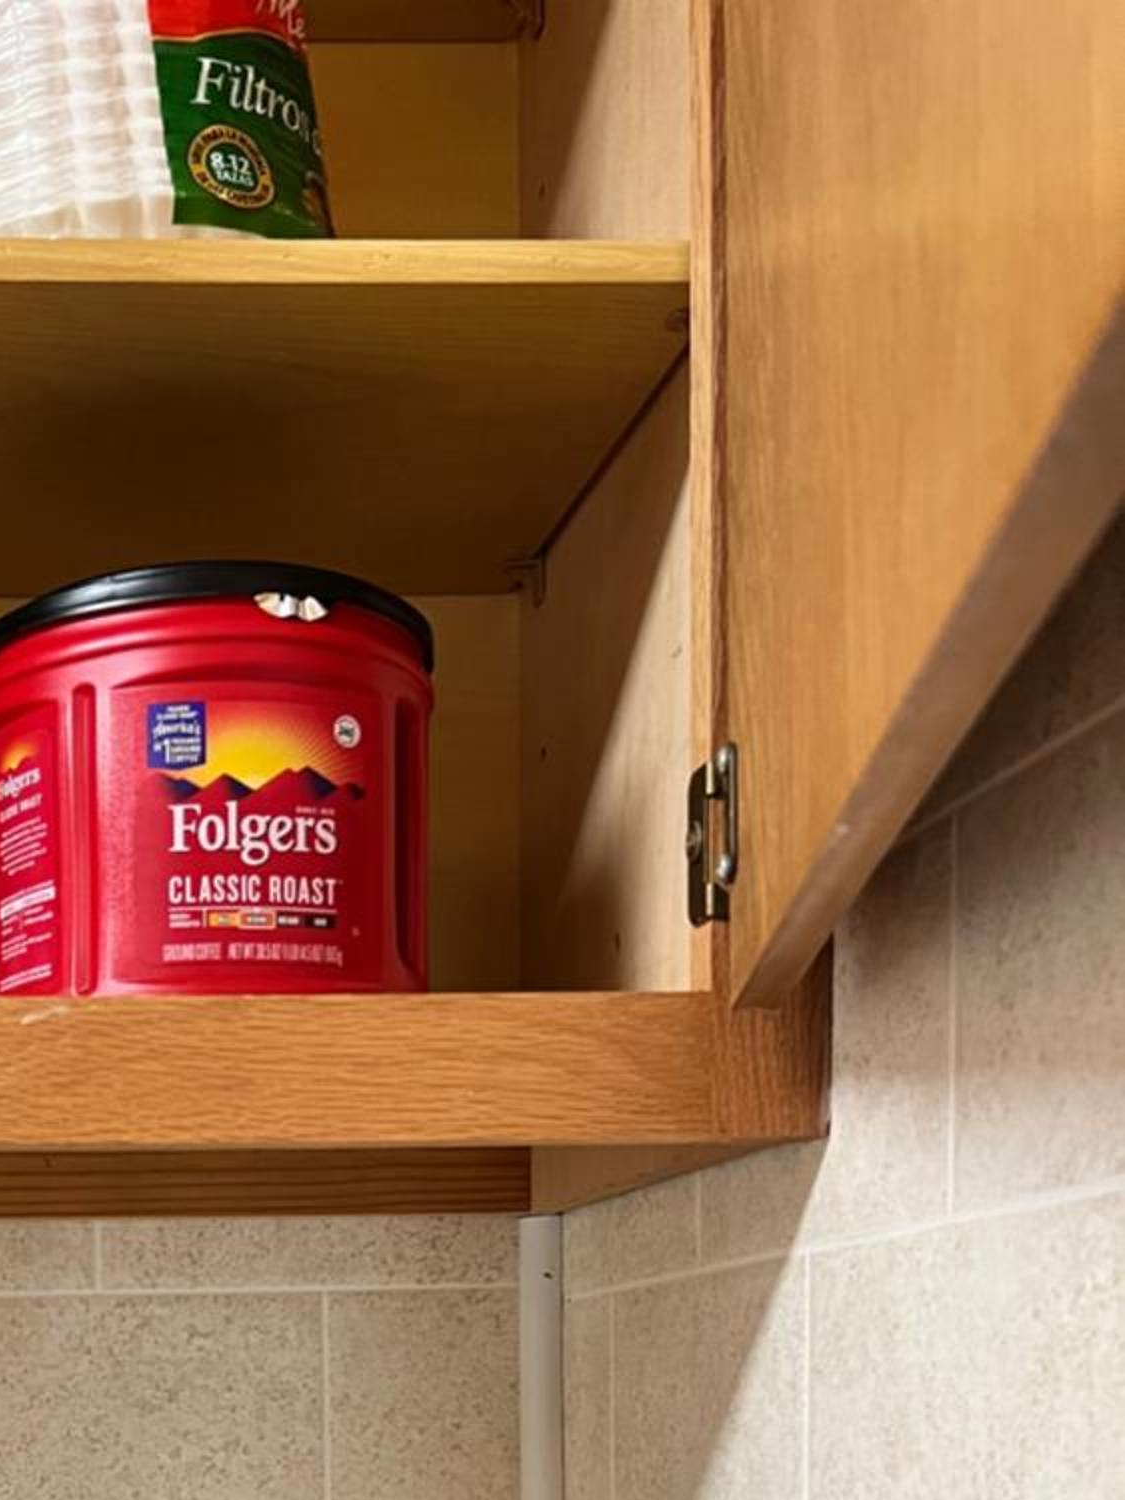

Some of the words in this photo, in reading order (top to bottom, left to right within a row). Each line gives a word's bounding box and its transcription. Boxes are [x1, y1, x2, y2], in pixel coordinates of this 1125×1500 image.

[209, 152, 251, 175] 8-12
[168, 800, 337, 866] Folgers
[168, 874, 261, 904] CLASSIC
[269, 875, 336, 906] ROAST
